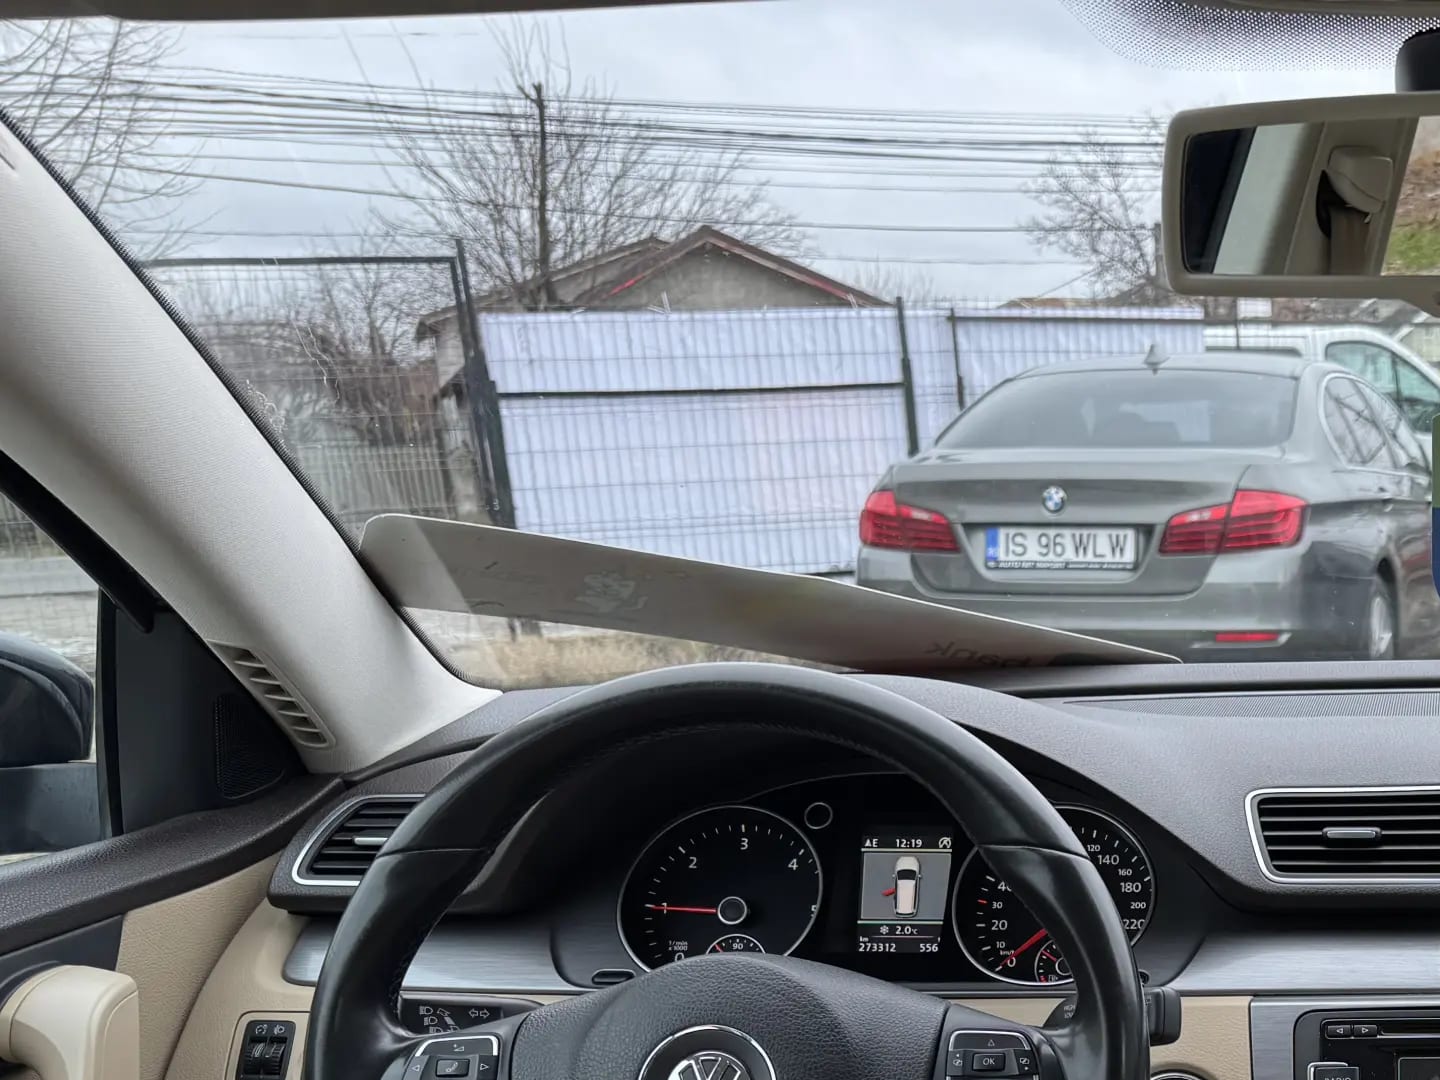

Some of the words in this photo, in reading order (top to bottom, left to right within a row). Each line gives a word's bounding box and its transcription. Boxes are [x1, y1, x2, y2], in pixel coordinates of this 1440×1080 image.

[1004, 532, 1028, 558] IS
[1037, 532, 1066, 558] 96
[1071, 532, 1129, 559] WLW
[740, 838, 749, 850] 3
[895, 839, 923, 848] 12:19
[1087, 844, 1101, 852] 120
[688, 856, 698, 869] 2
[787, 858, 799, 871] 4
[1097, 854, 1120, 865] 140
[1118, 868, 1133, 876] 160
[997, 881, 1012, 892] 4
[1120, 882, 1142, 893] 180
[992, 901, 1003, 909] 30
[1130, 901, 1147, 909] 200
[991, 919, 1008, 931] 20
[732, 942, 744, 951] 90
[858, 943, 897, 952] 273312
[919, 943, 939, 953] 556
[996, 941, 1006, 949] 10
[982, 1057, 995, 1066] OK
